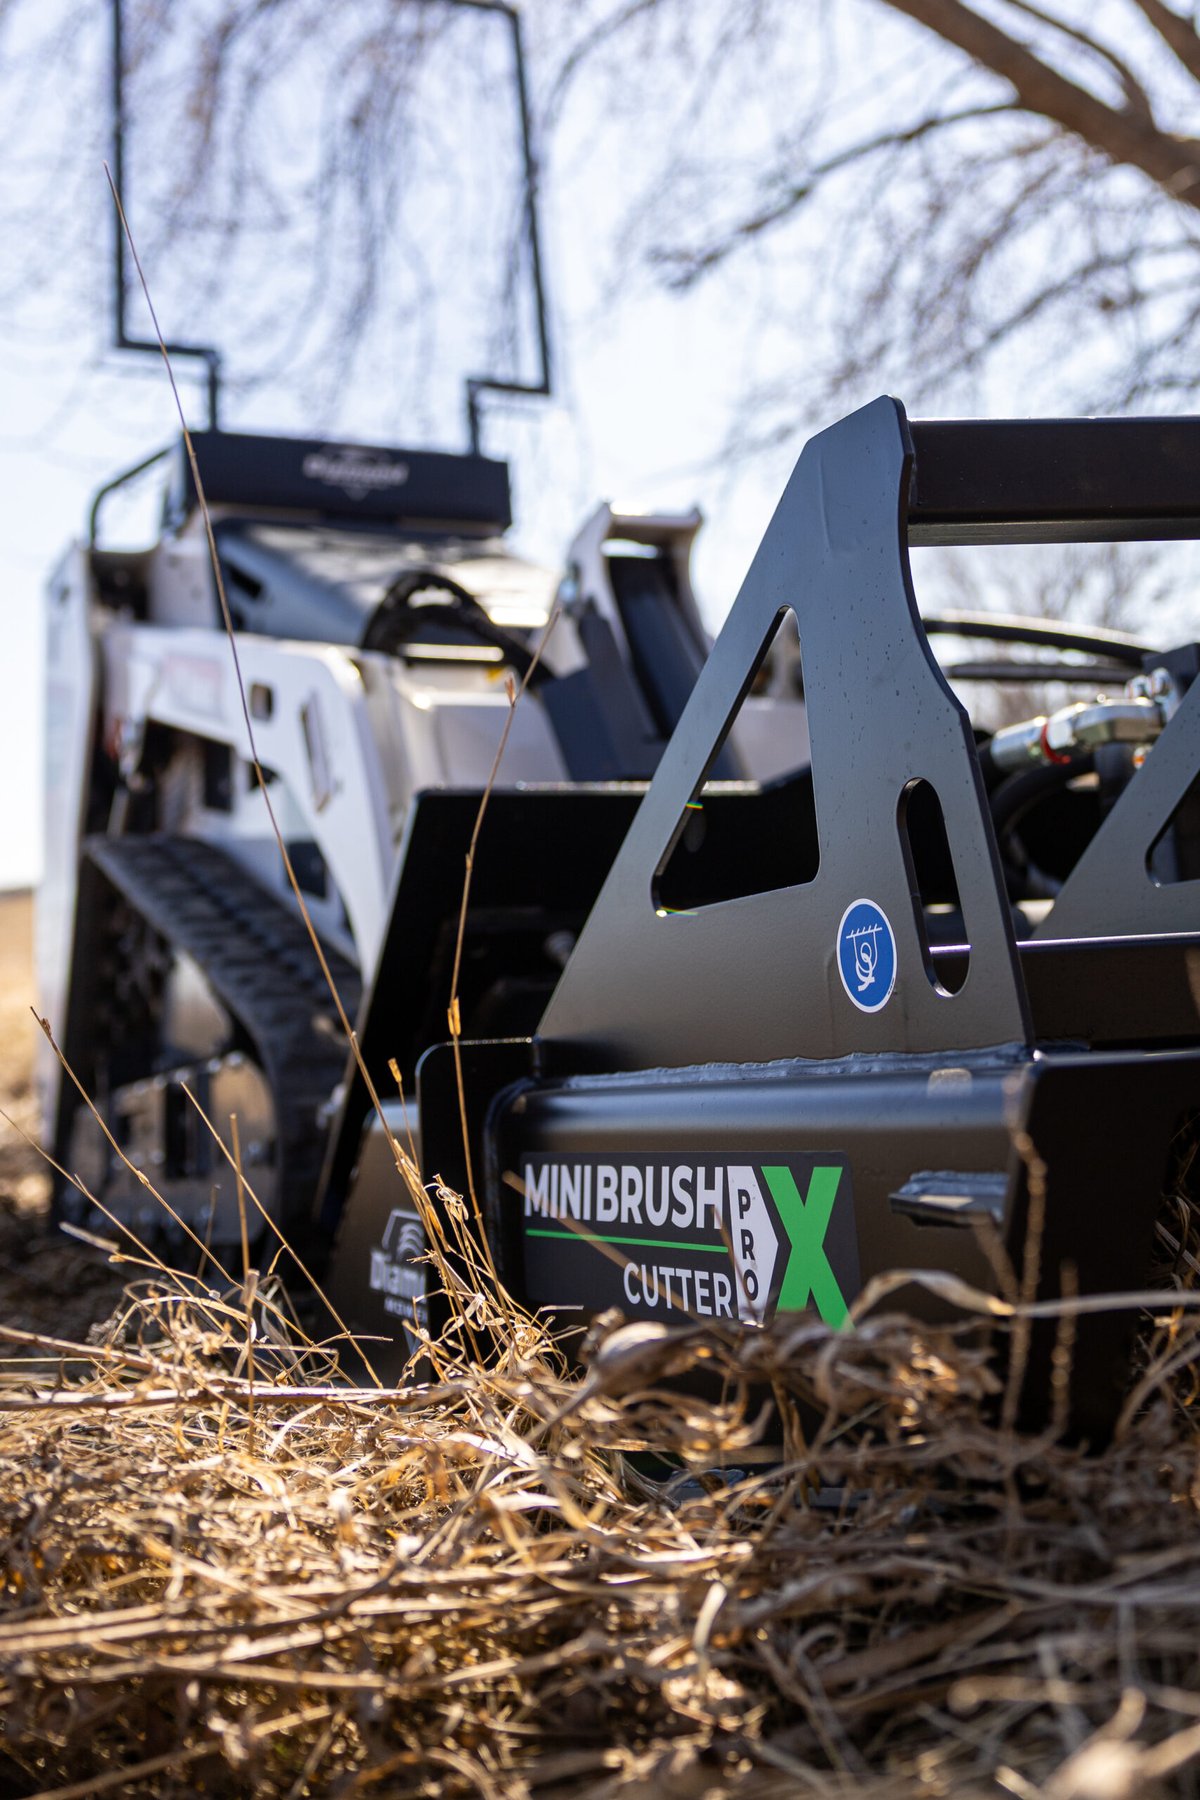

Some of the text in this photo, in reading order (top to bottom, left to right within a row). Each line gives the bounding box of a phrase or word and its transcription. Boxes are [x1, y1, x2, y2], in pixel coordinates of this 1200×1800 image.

[623, 1262, 734, 1319] CUTTER
[737, 1188, 759, 1302] PRO
[761, 1166, 856, 1331] X
